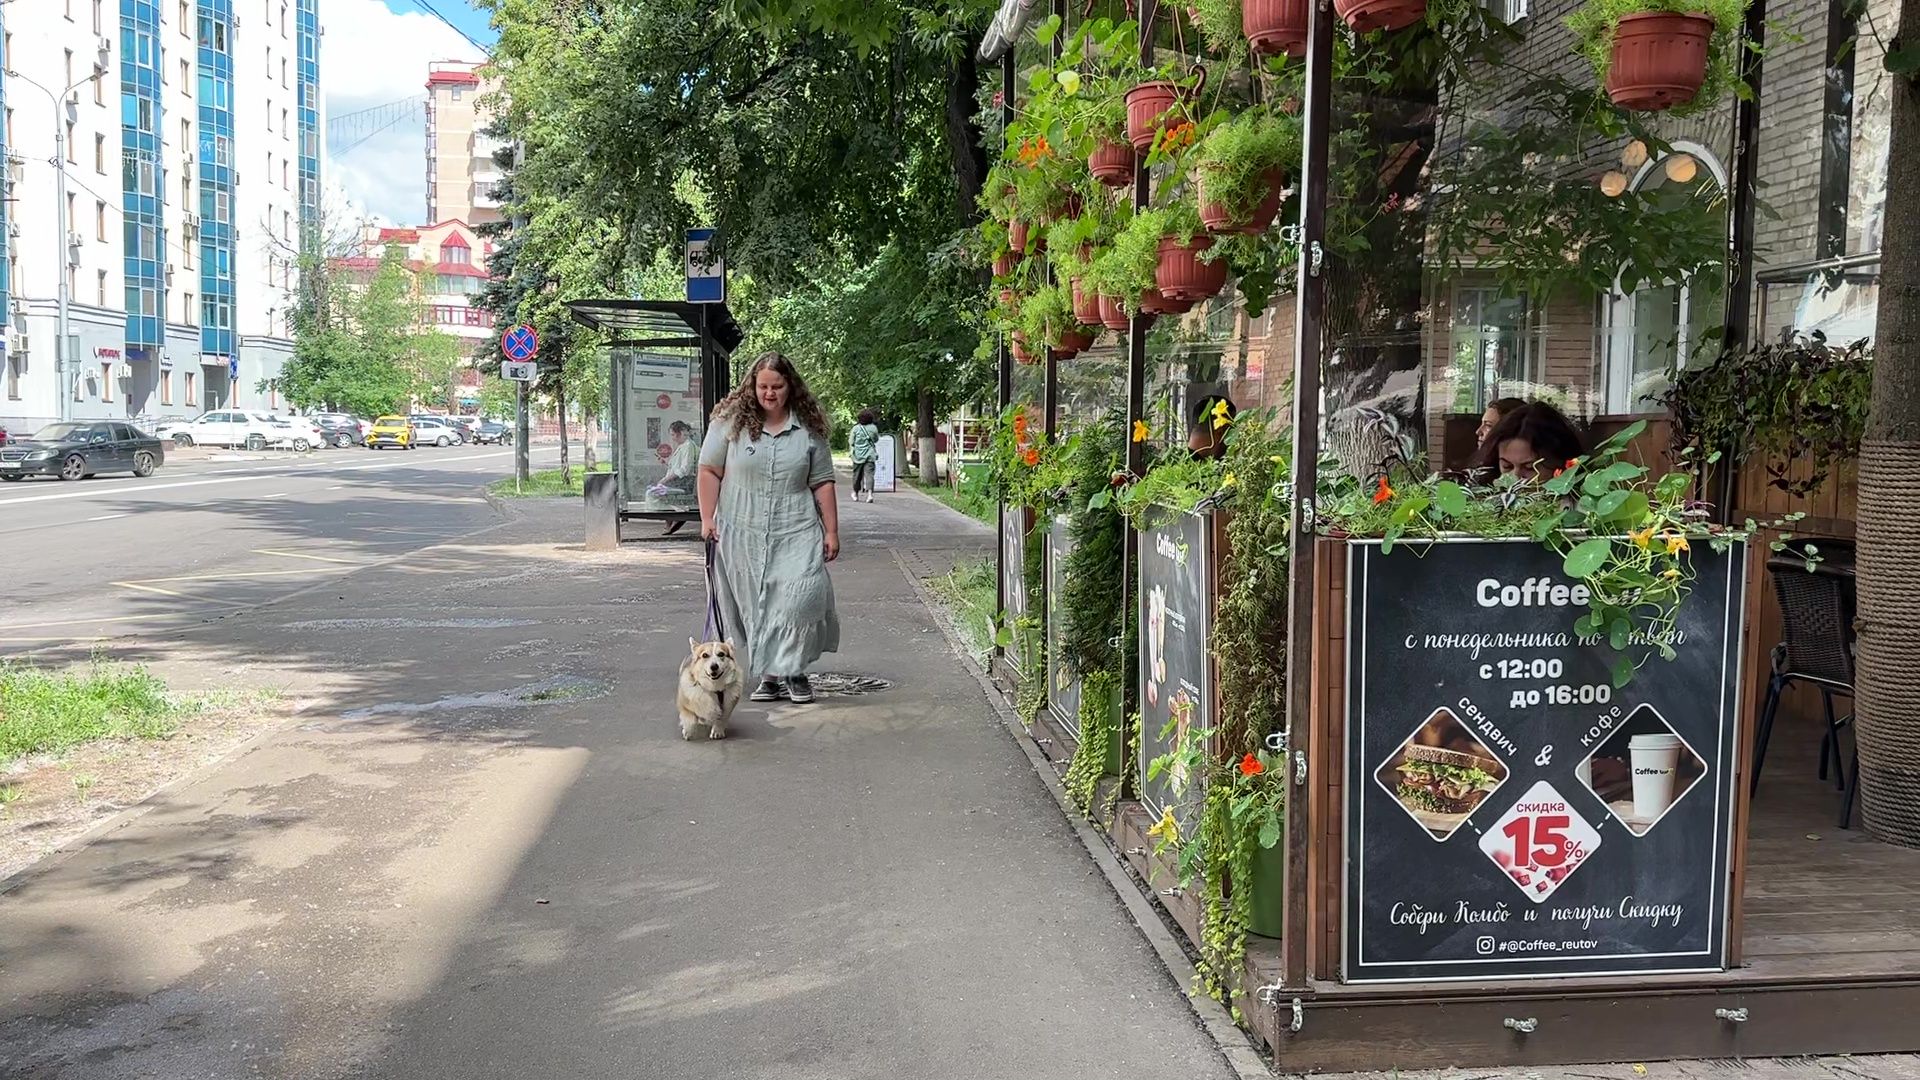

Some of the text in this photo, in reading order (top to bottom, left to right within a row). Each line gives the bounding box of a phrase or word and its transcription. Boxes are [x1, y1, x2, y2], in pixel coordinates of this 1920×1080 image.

[1156, 532, 1176, 560] Coffee
[1476, 576, 1591, 608] Coffee
[1423, 632, 1572, 661] понедельника
[1478, 658, 1564, 680] с 12:00
[1509, 684, 1612, 709] до 16:00
[1457, 696, 1623, 767] сендвич & кофе
[1634, 767, 1660, 776] Coffee
[1515, 800, 1566, 815] скидка
[1501, 815, 1584, 868] 15%
[1390, 895, 1684, 935] Собери Комбо и получи Скидку
[1498, 939, 1599, 953] #@Coffee_reutov
